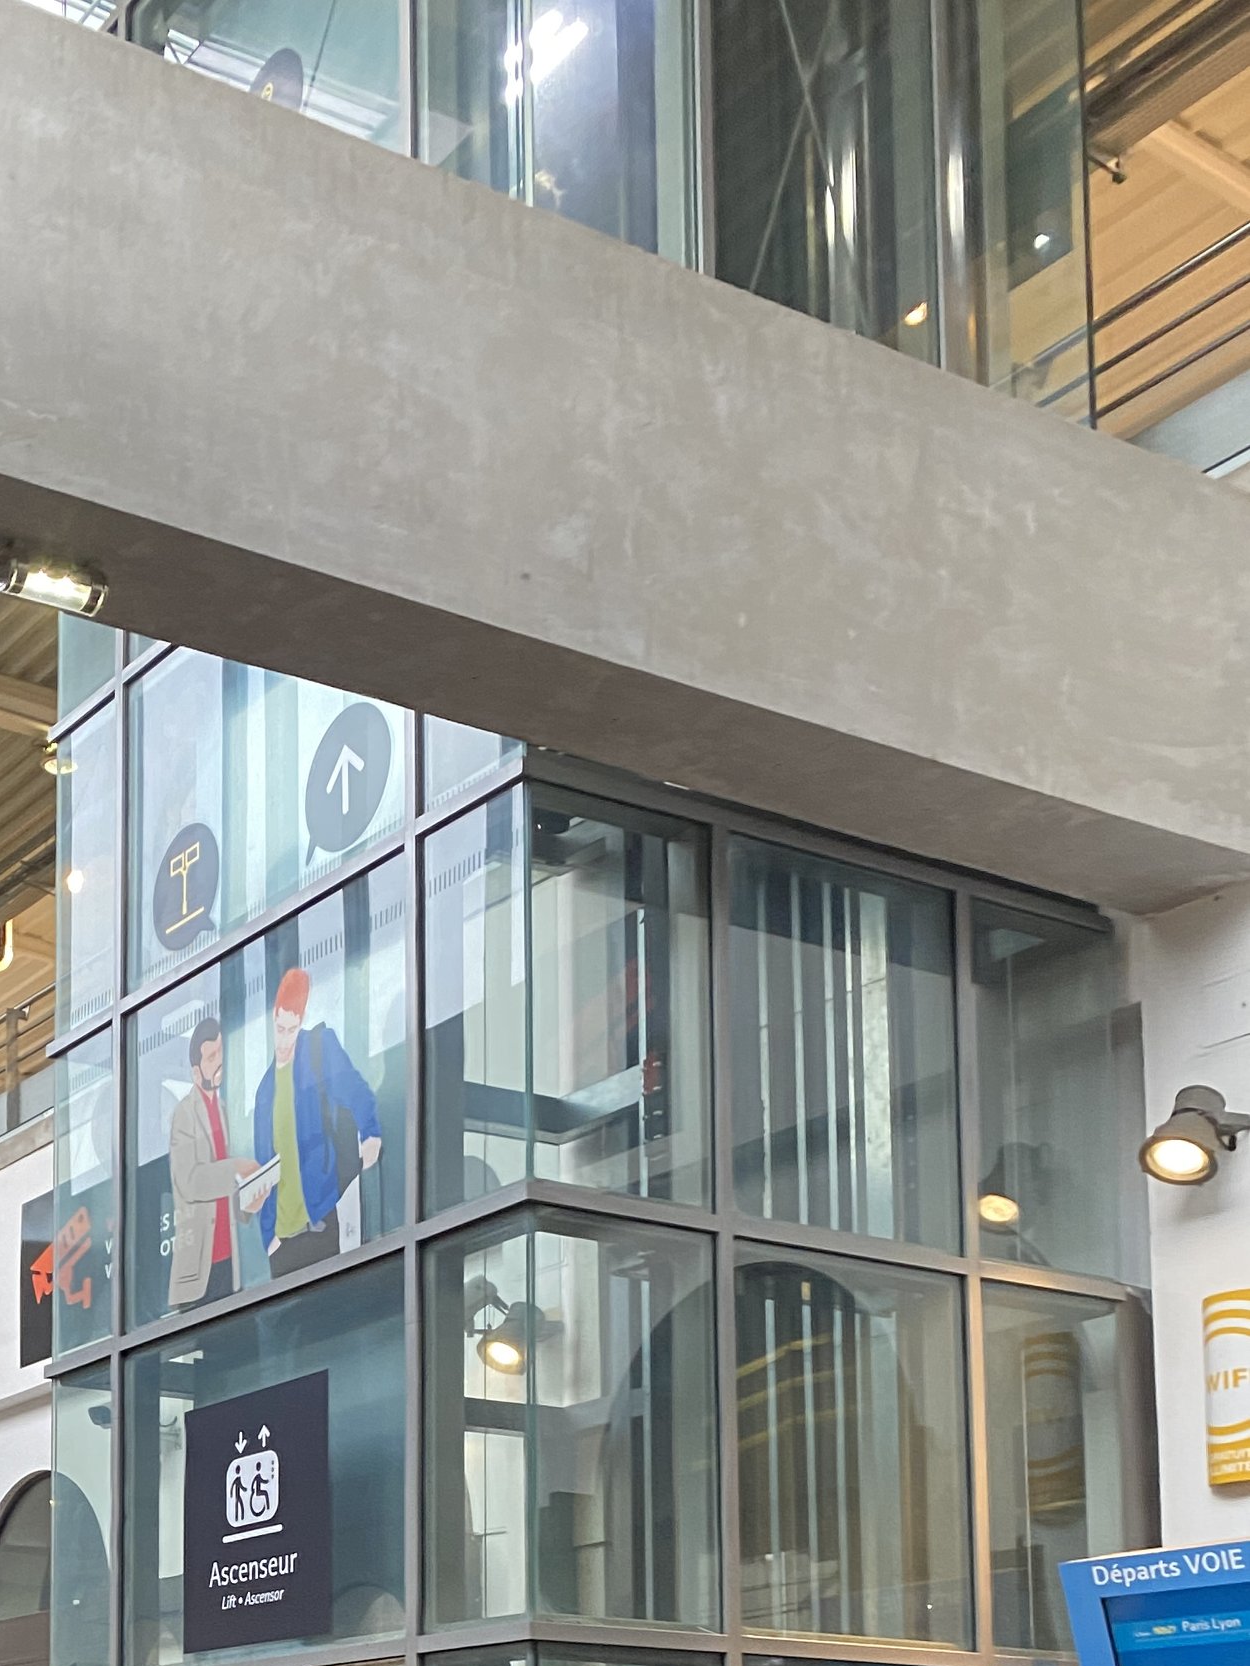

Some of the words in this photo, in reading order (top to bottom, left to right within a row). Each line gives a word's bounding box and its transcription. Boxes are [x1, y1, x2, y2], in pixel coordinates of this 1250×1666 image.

[1207, 1368, 1250, 1392] WIF
[208, 1552, 298, 1588] Ascenseur
[1091, 1560, 1181, 1587] Départs
[1183, 1548, 1246, 1575] VOIE
[221, 1594, 237, 1610] Lift
[244, 1589, 285, 1606] Ascensor
[1181, 1620, 1210, 1632] Paris
[1211, 1617, 1241, 1631] Lyon
